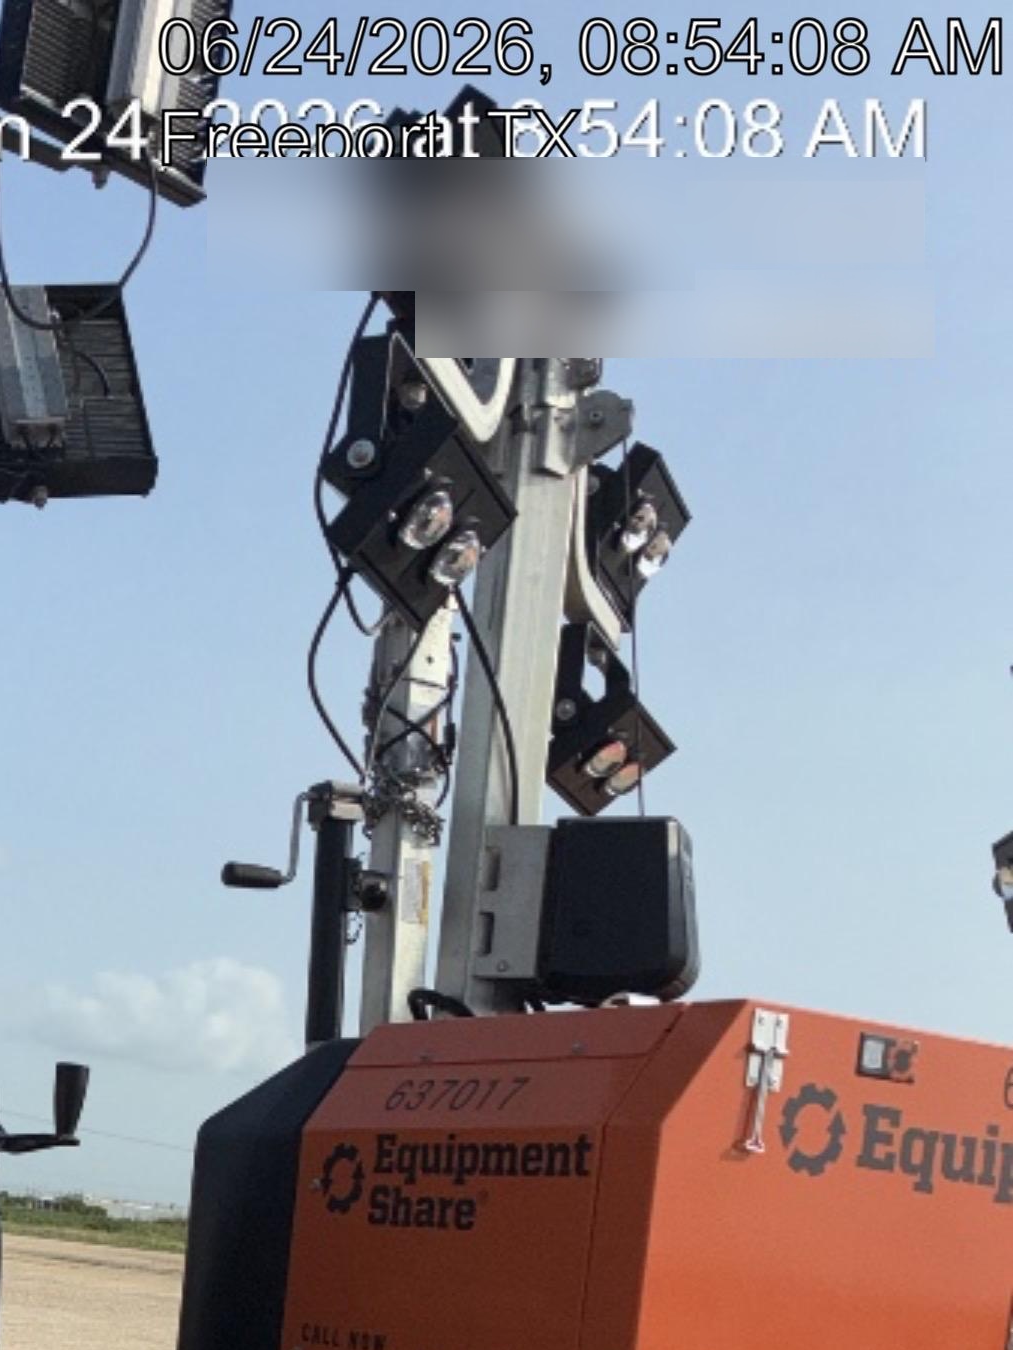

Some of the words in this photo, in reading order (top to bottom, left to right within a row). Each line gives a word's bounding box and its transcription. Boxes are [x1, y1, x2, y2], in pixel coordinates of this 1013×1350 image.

[385, 1077, 530, 1110] 637017
[373, 1133, 592, 1185] Equipment
[368, 1185, 475, 1230] Share
[301, 1323, 338, 1347] CALL
